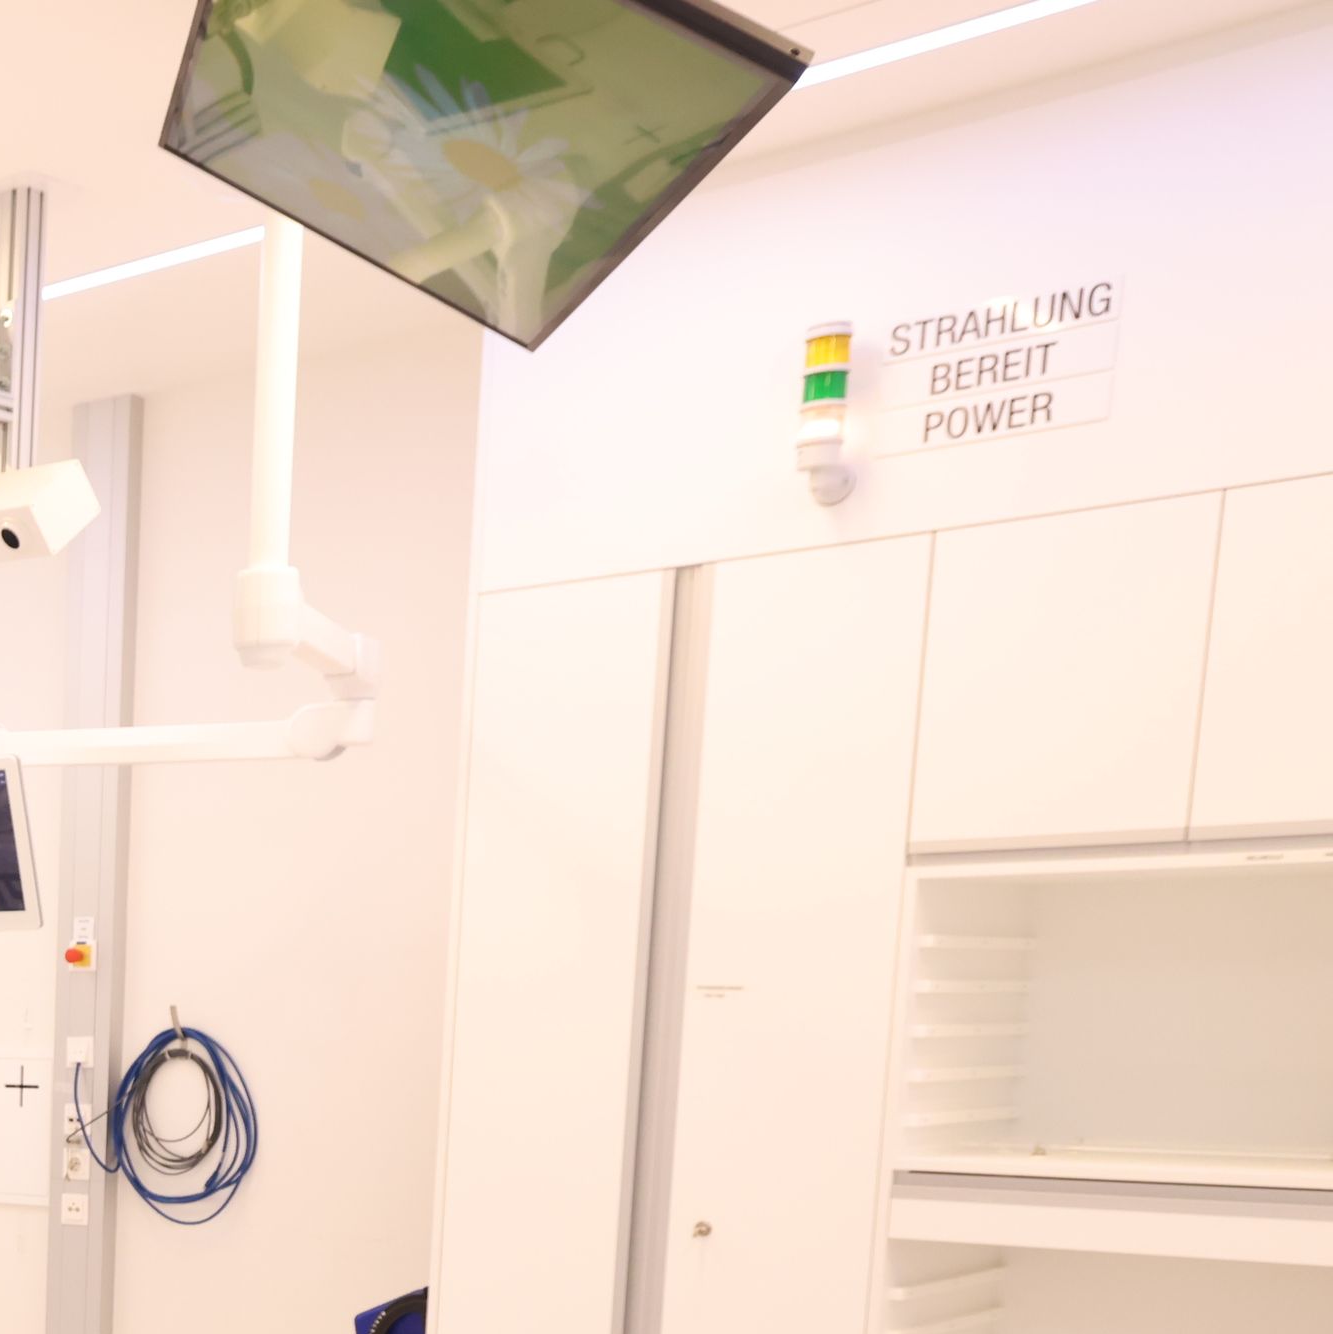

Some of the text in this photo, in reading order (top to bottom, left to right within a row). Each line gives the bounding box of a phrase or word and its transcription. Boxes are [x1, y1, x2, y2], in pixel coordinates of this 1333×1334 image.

[889, 282, 1112, 357] STRAHLUNG
[930, 341, 1058, 395] BEREIT
[922, 392, 1054, 443] POWER
